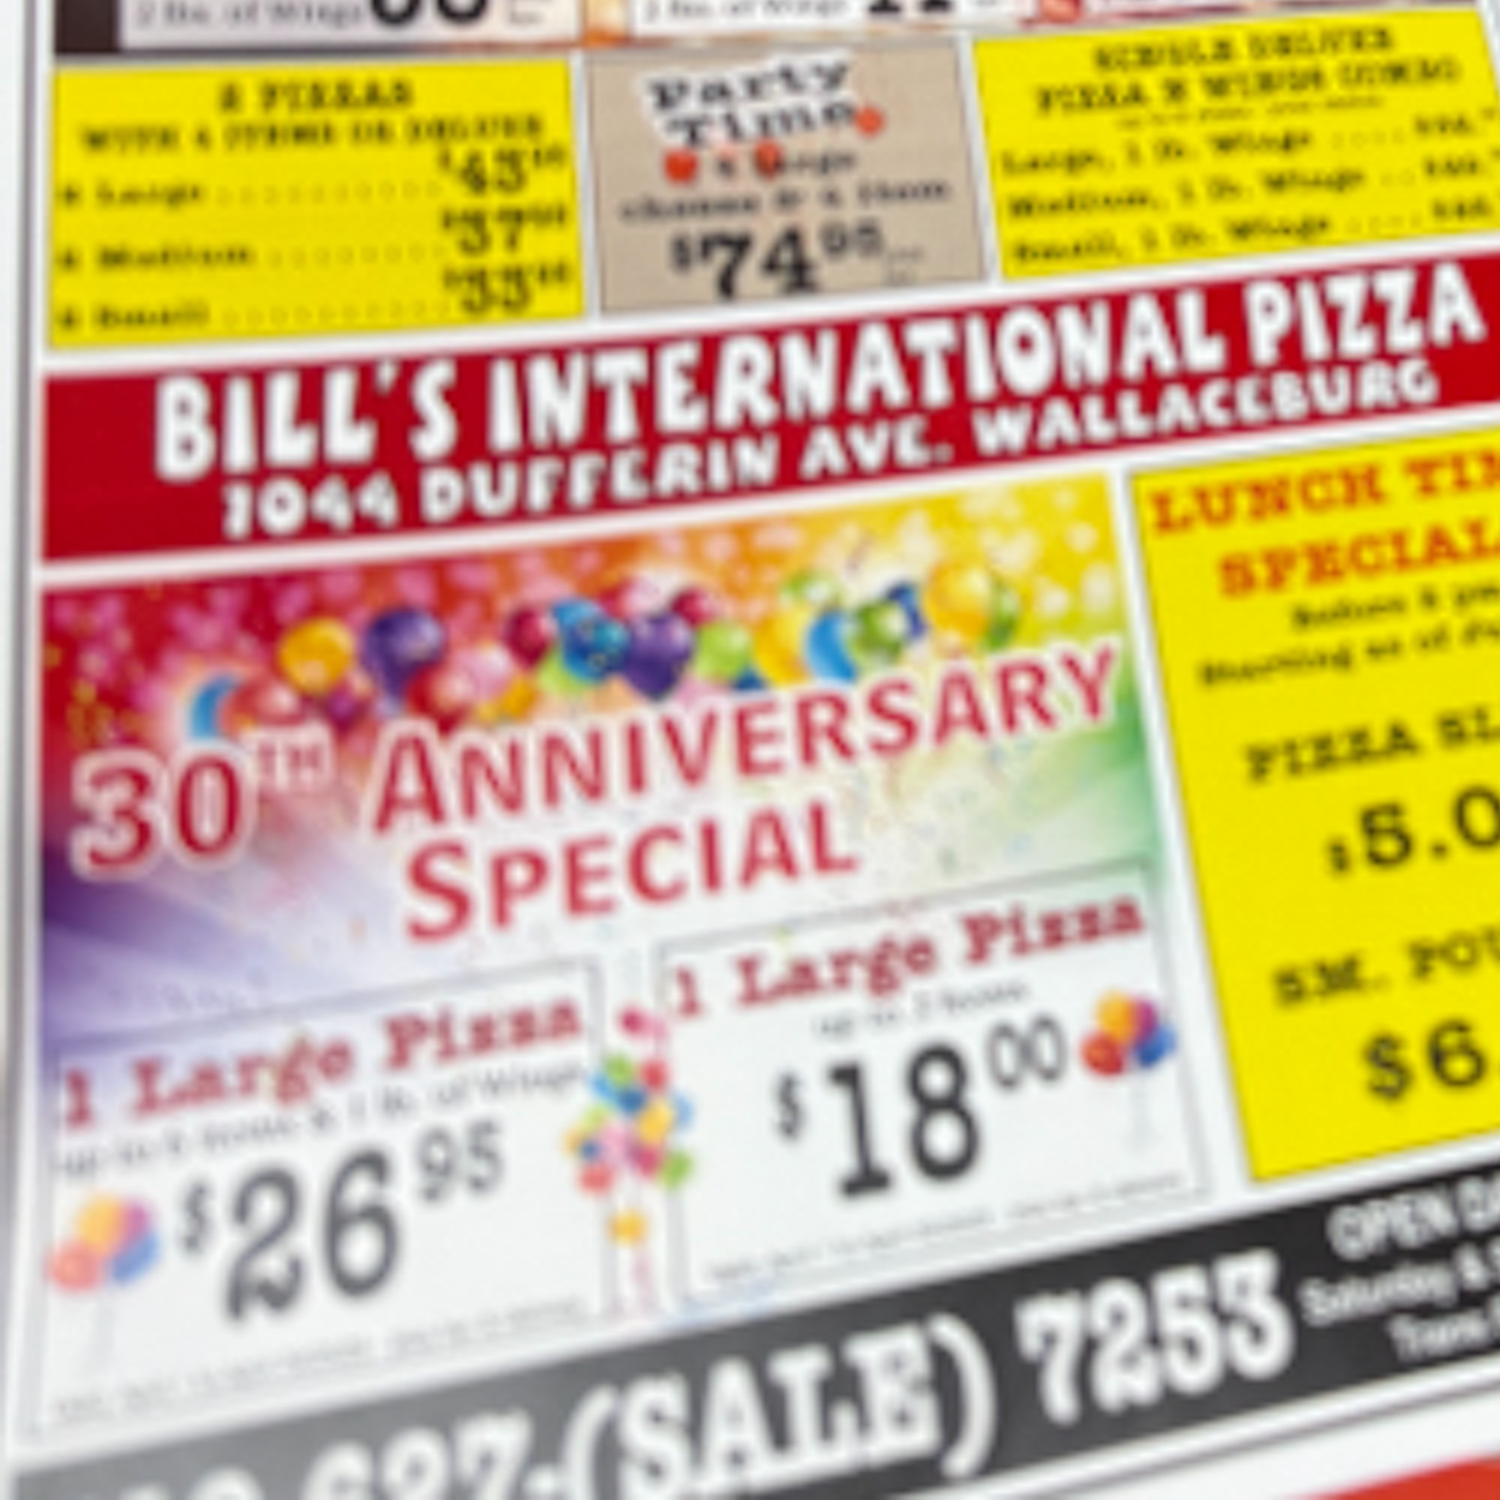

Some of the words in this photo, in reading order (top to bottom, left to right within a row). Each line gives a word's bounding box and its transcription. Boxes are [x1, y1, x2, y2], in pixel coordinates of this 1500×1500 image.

[259, 79, 413, 111] PIZZAS
[651, 60, 849, 111] Party
[666, 101, 857, 147] Time
[154, 360, 460, 484] BILL'S
[489, 286, 1226, 454] INTERNATIONAL
[1243, 259, 1487, 370] PIZZA
[223, 474, 401, 541] 1044
[420, 432, 781, 523] DUFFERIN
[803, 410, 953, 482] AVE.
[1149, 461, 1385, 535] LUNCH
[375, 644, 1120, 833] ANNIVERSARY
[1244, 721, 1420, 785] PIZZA
[405, 798, 860, 943] SPECIAL
[677, 967, 705, 1017] 1
[736, 935, 935, 1008] Large
[962, 897, 1146, 965] Pizza
[1272, 952, 1388, 1008] SM.
[64, 1066, 93, 1129] 1
[131, 1035, 355, 1117] Large
[384, 999, 581, 1070] Pizza
[1327, 1181, 1458, 1262] OPEN
[1300, 1262, 1458, 1326] Saturday
[1015, 1249, 1296, 1425] 7253
[1387, 1310, 1491, 1362] Trans
